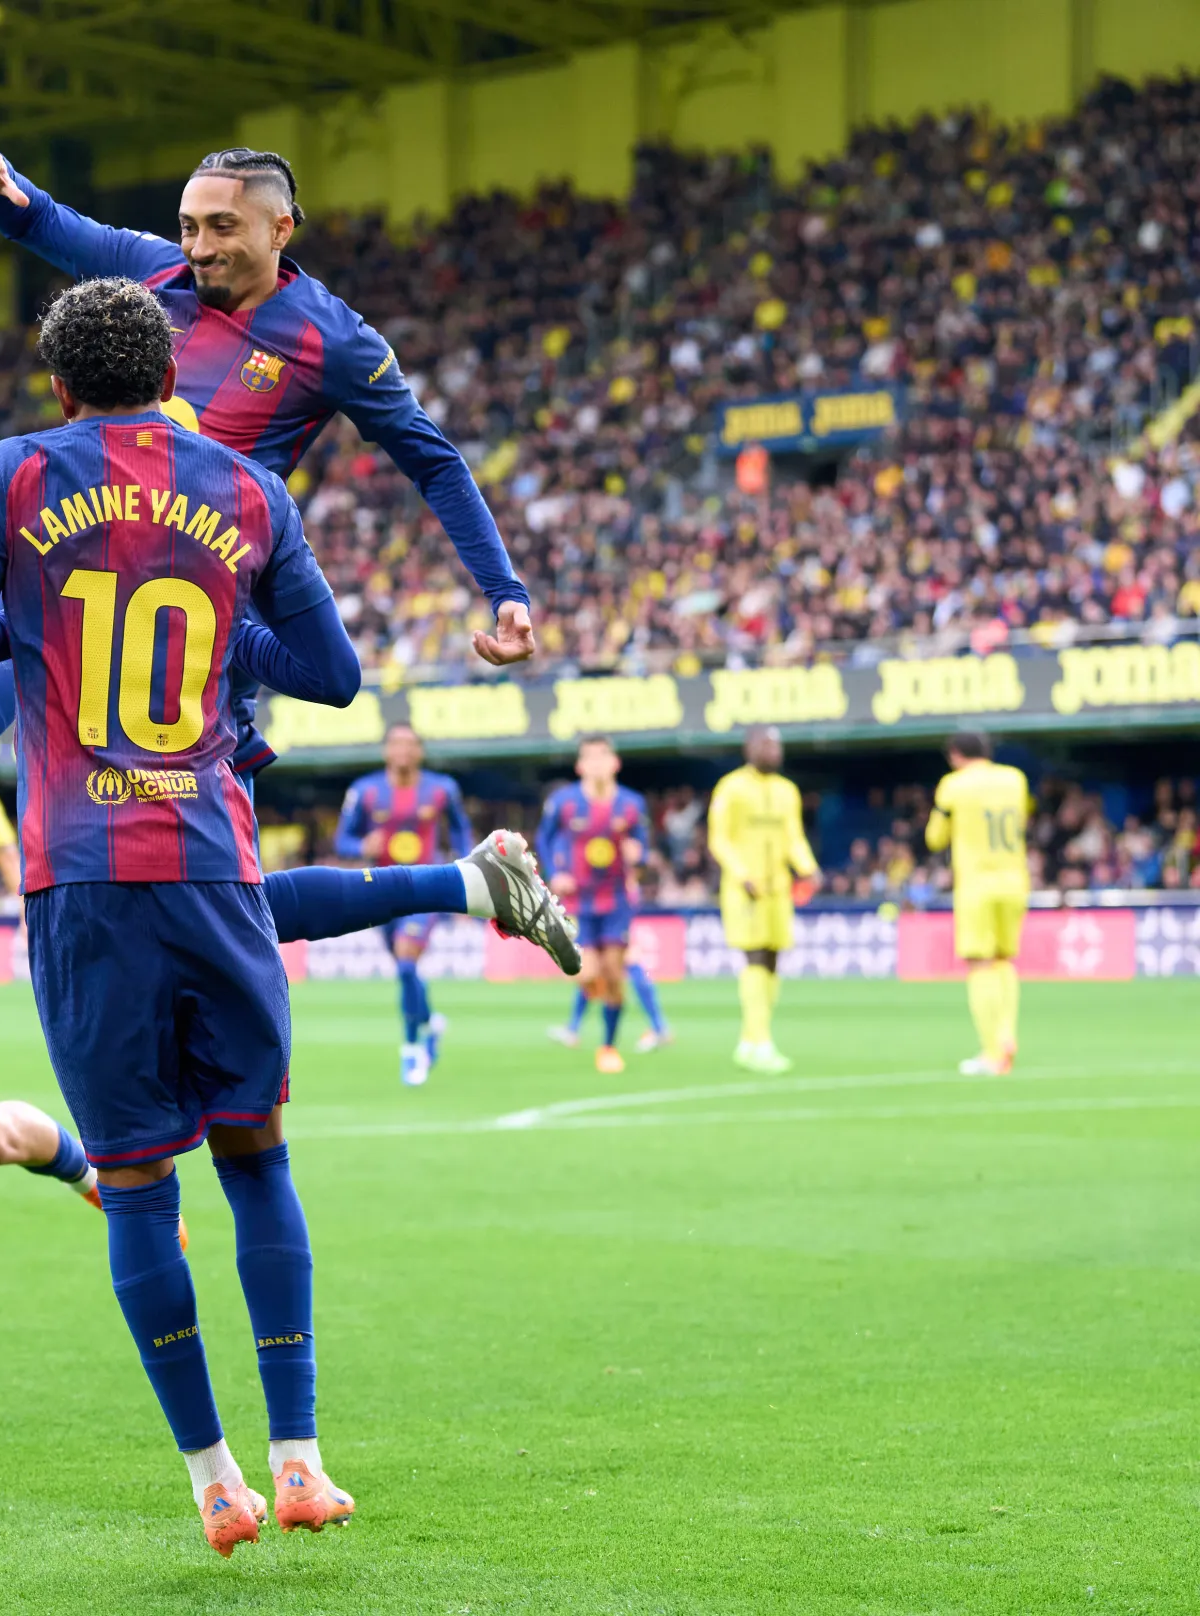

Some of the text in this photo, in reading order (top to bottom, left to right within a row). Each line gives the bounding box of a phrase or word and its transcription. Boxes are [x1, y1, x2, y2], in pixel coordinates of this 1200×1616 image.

[19, 485, 252, 574] LAMINE YAMAL
[60, 569, 217, 753] 10
[126, 769, 196, 784] UNHCR
[134, 777, 199, 797] ACNUR
[155, 793, 179, 801] Refugee
[983, 806, 1021, 853] 10
